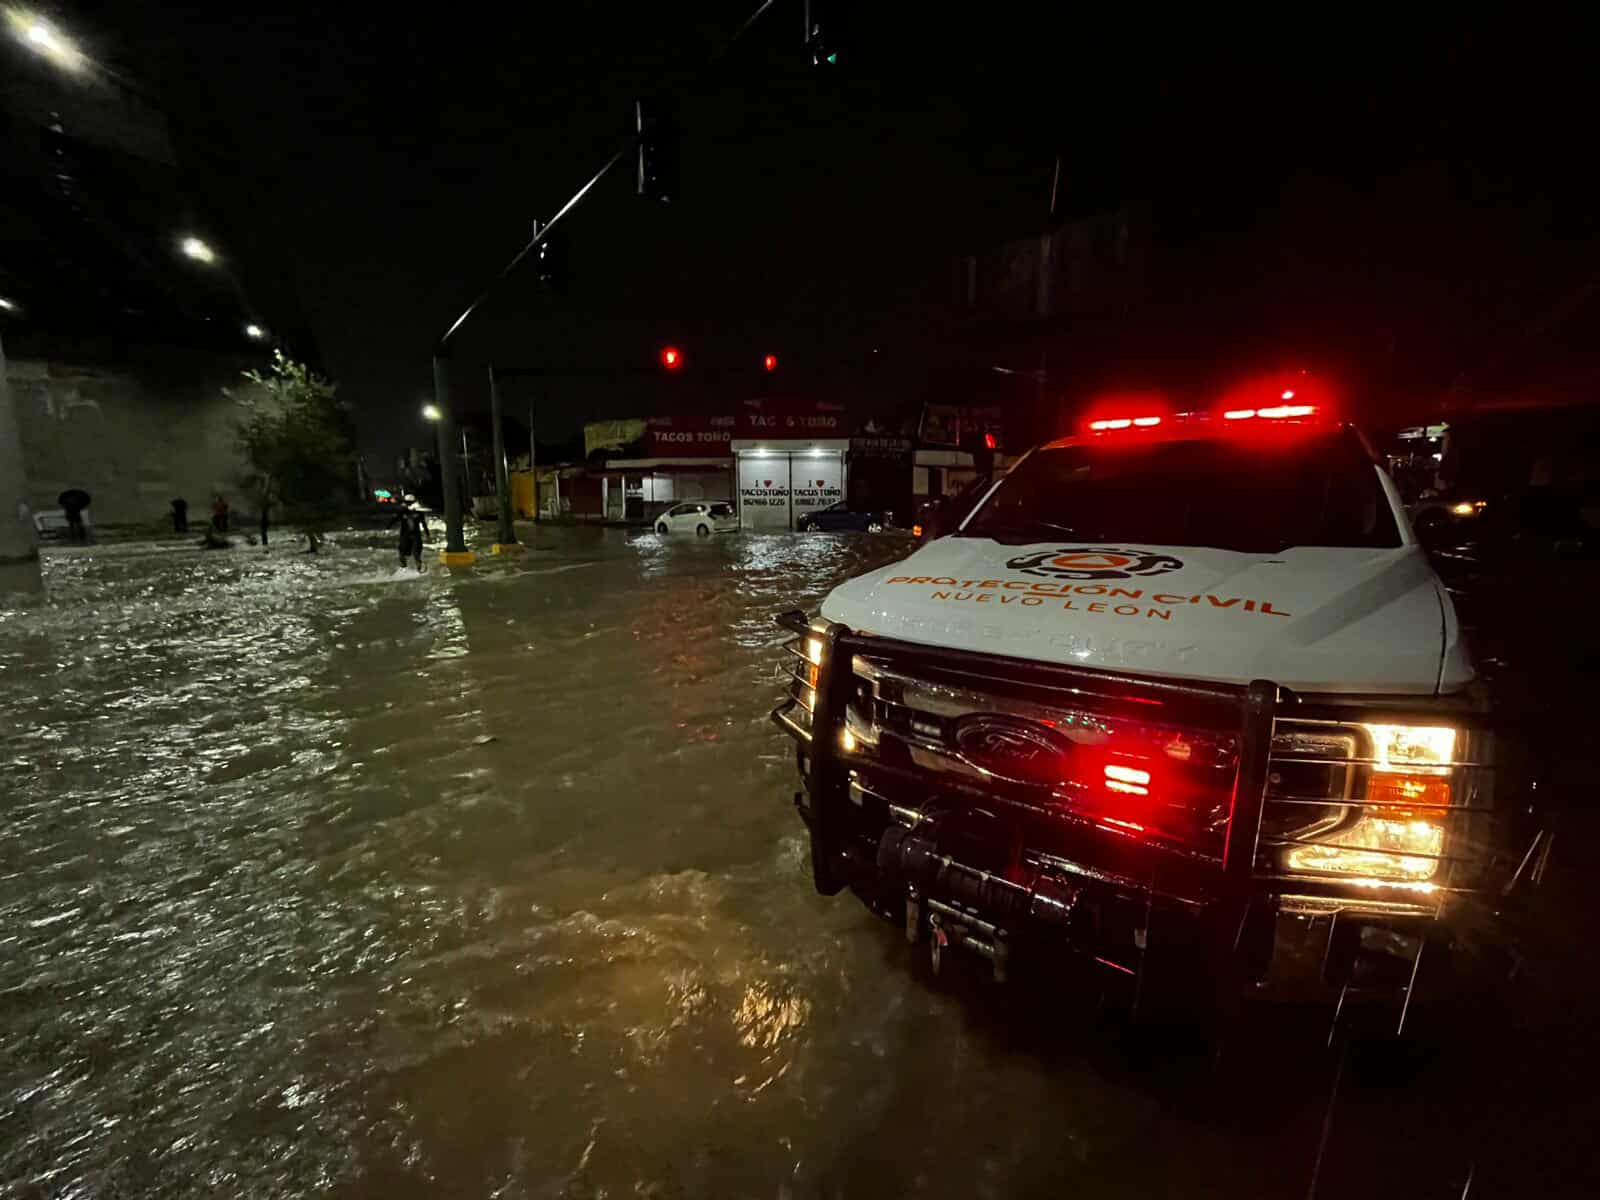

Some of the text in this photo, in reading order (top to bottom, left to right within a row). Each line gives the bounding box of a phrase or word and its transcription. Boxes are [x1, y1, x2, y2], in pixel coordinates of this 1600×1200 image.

[749, 415, 795, 428] TACS
[653, 431, 693, 442] TACOS
[887, 576, 1291, 616] PROTECCIÓN CIVIL
[931, 591, 1044, 606] NUEVO
